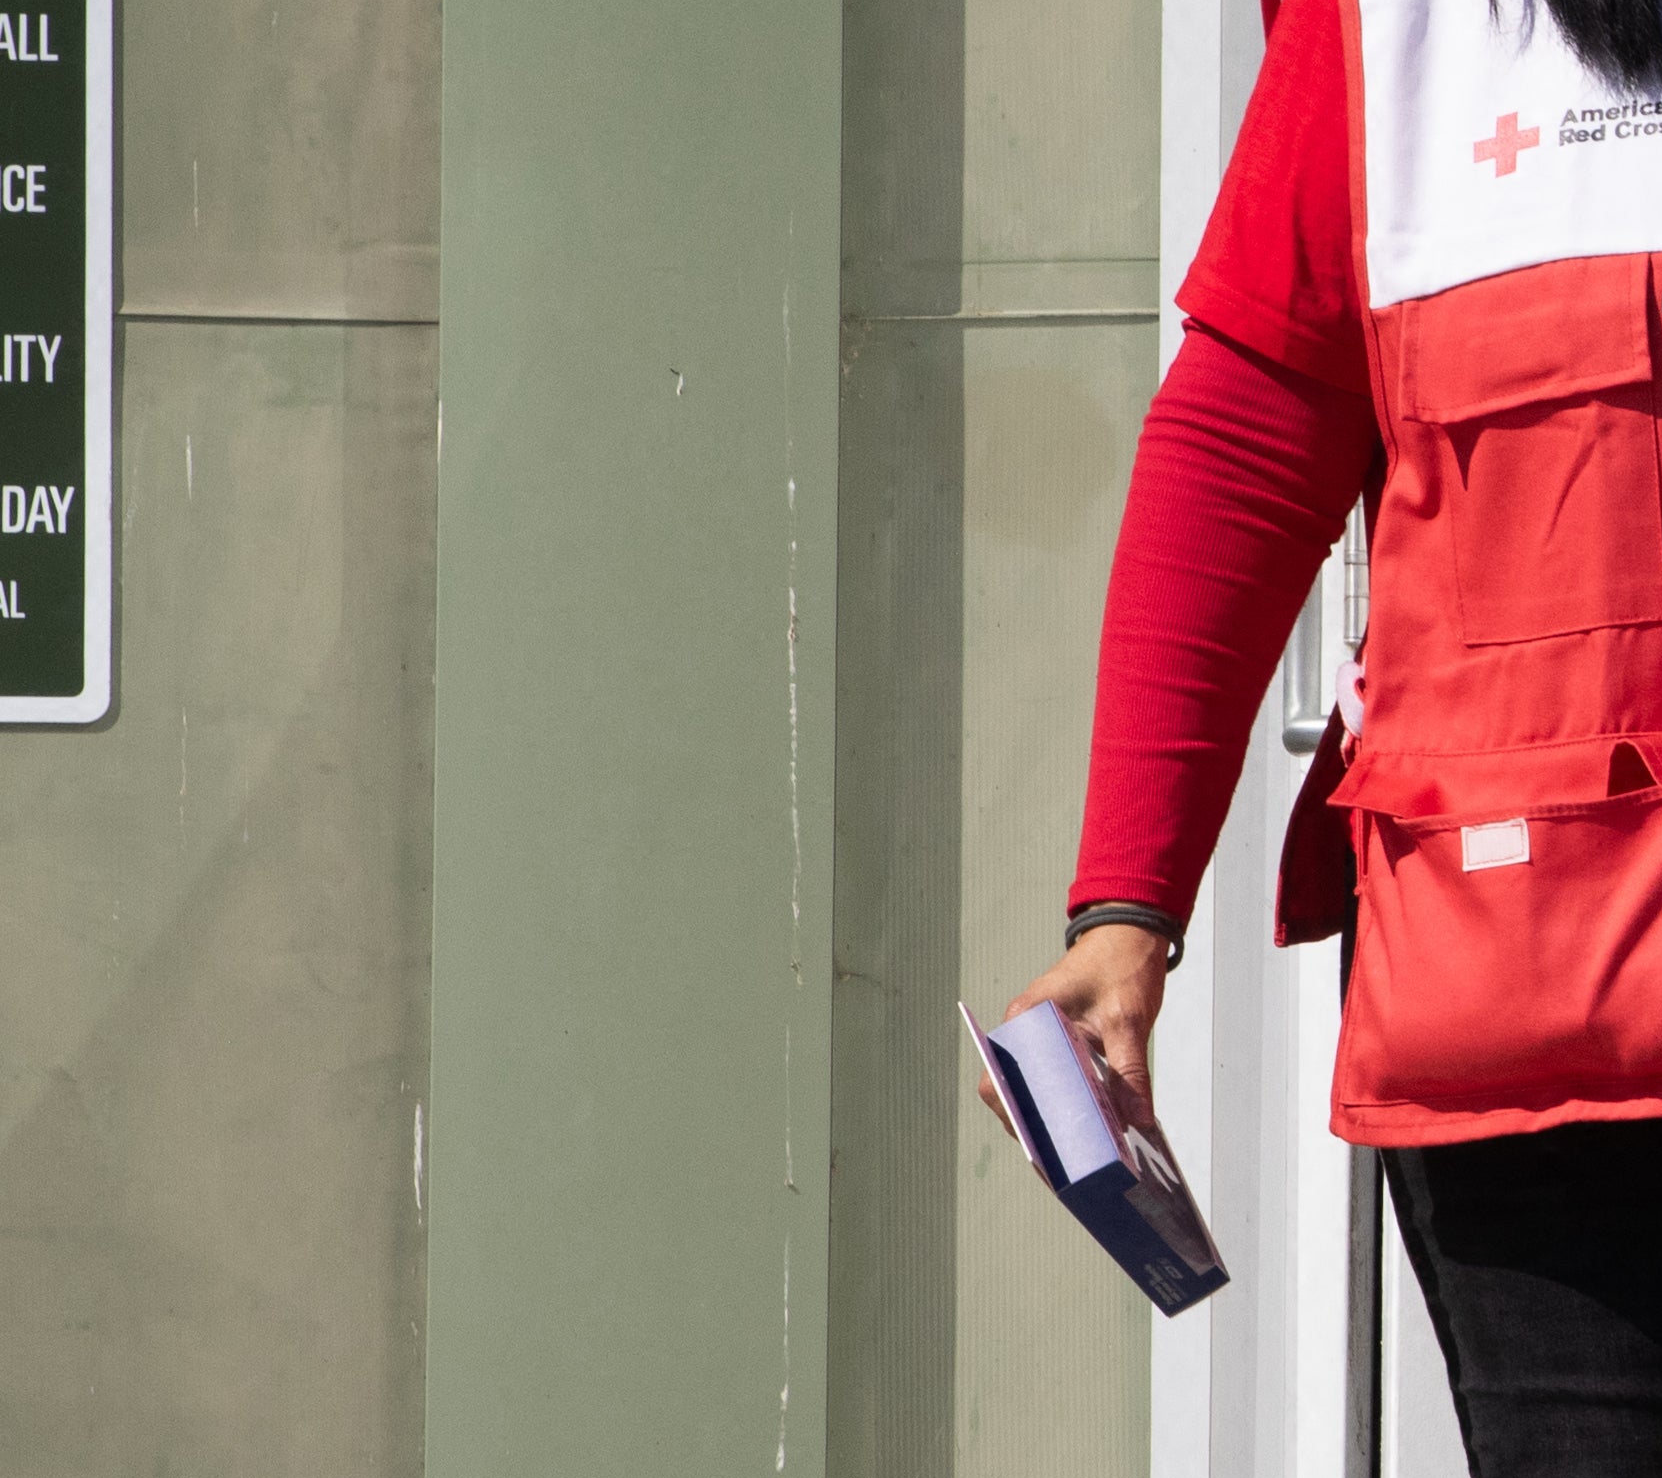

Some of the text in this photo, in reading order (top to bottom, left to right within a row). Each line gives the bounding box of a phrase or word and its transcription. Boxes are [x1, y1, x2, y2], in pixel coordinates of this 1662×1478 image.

[1559, 124, 1606, 147] Red
[0, 165, 47, 213] CE
[0, 334, 62, 384] ITY
[1, 485, 75, 534] DAY
